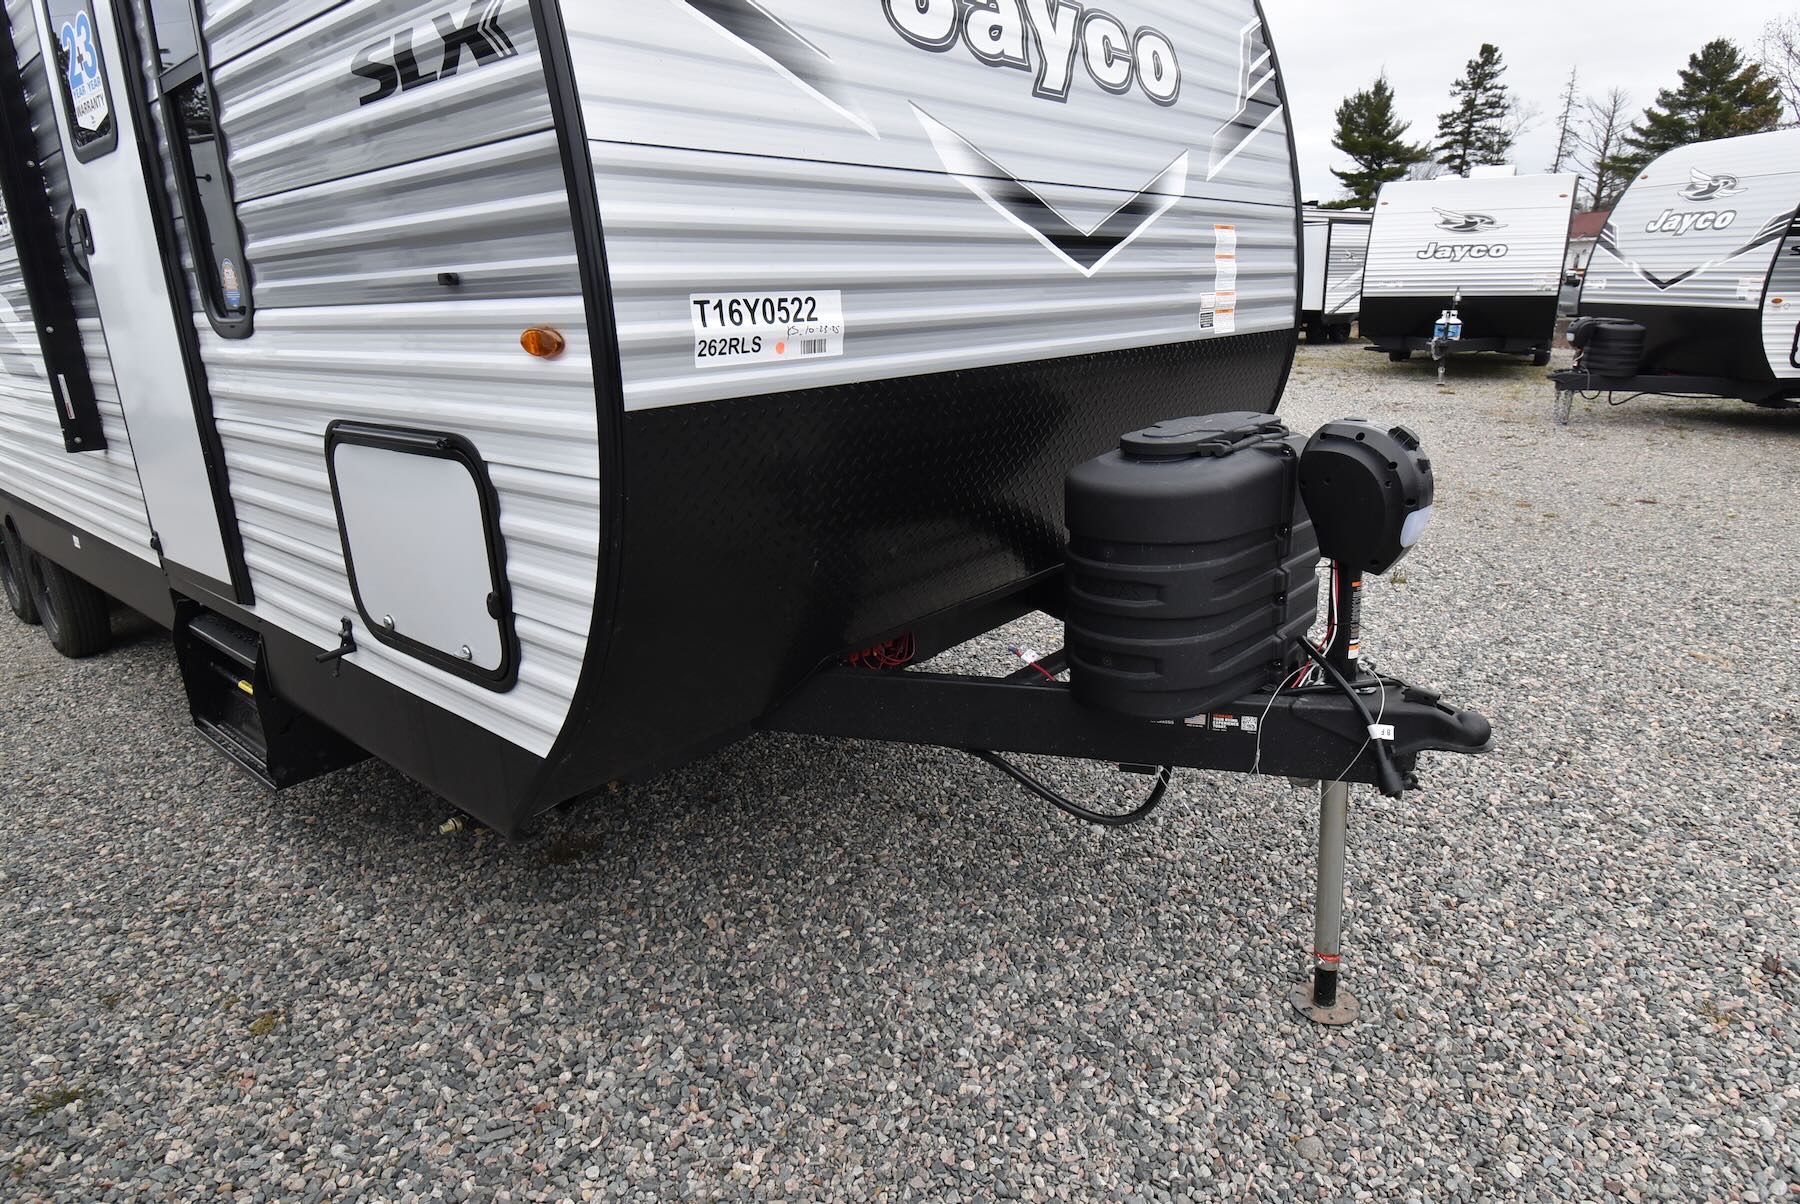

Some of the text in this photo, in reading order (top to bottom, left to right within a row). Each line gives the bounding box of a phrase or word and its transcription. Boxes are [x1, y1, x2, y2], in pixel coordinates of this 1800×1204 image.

[351, 0, 518, 106] SLX
[87, 76, 101, 91] YEAR
[76, 93, 105, 118] WARRANTY
[1645, 208, 1737, 236] Jayco
[1416, 242, 1508, 262] Jayco
[693, 297, 818, 328] T16Y0522
[697, 336, 762, 357] 262RLS
